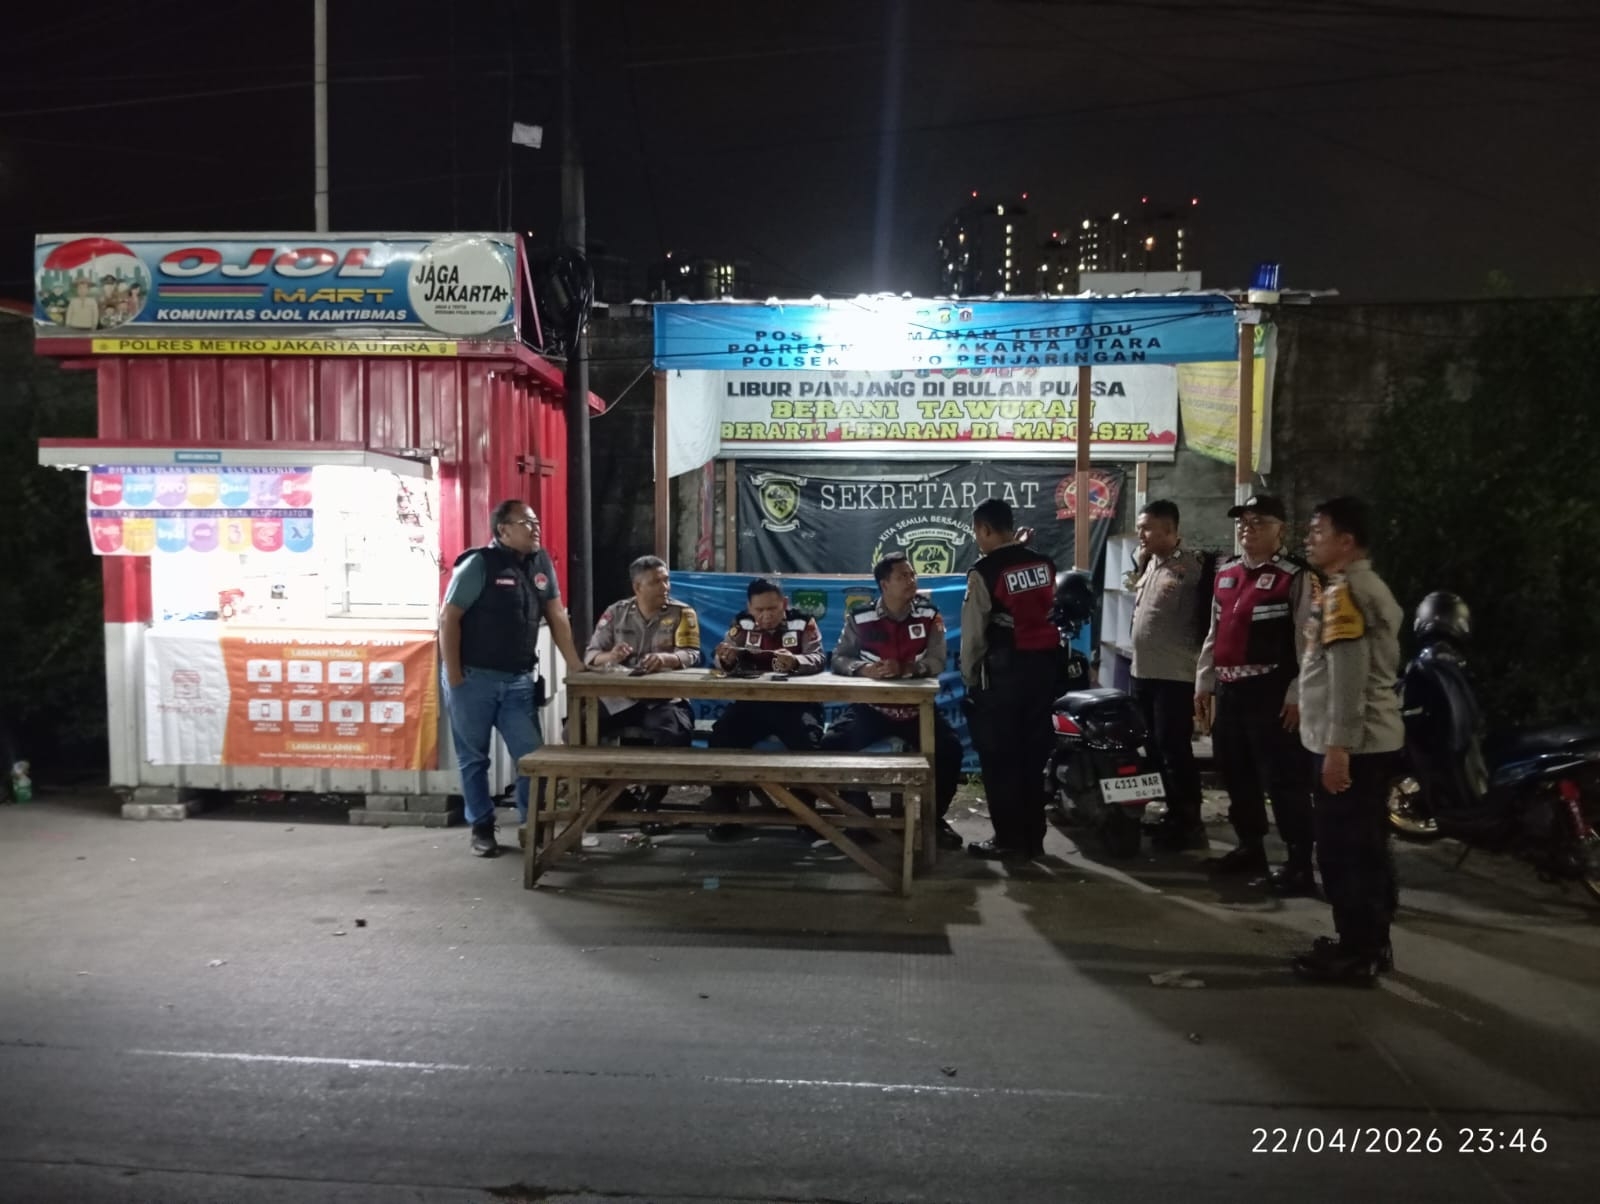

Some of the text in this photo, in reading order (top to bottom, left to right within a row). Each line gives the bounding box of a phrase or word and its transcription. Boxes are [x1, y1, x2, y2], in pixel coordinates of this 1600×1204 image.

[159, 247, 387, 278] OJOL
[415, 262, 460, 285] JAGA
[273, 287, 394, 303] MART
[157, 309, 407, 321] KOMUNITAS OJOL KAMTIBMAS
[755, 330, 803, 342] POS
[1013, 325, 1133, 339] TERPADU
[119, 340, 430, 353] POLRES METRO JAKARTA UTARA
[728, 342, 826, 354] POLRES
[1075, 337, 1162, 349] UTARA
[742, 356, 840, 367] POLSEK
[957, 351, 1147, 366] PENJARINGAN
[727, 381, 792, 397] LIBUR
[799, 381, 916, 398] PANJANG
[922, 381, 945, 396] DI
[952, 381, 1033, 397] BULAN
[771, 399, 899, 420] BERANI
[719, 421, 828, 441] BERARTI
[839, 421, 959, 441] LEBARAN
[970, 422, 999, 440] DI
[820, 481, 1040, 510] SEKRETARIAT
[880, 526, 897, 543] KITA
[896, 515, 929, 531] SEMUA
[1007, 565, 1050, 593] POLISI
[1103, 781, 1111, 791] K
